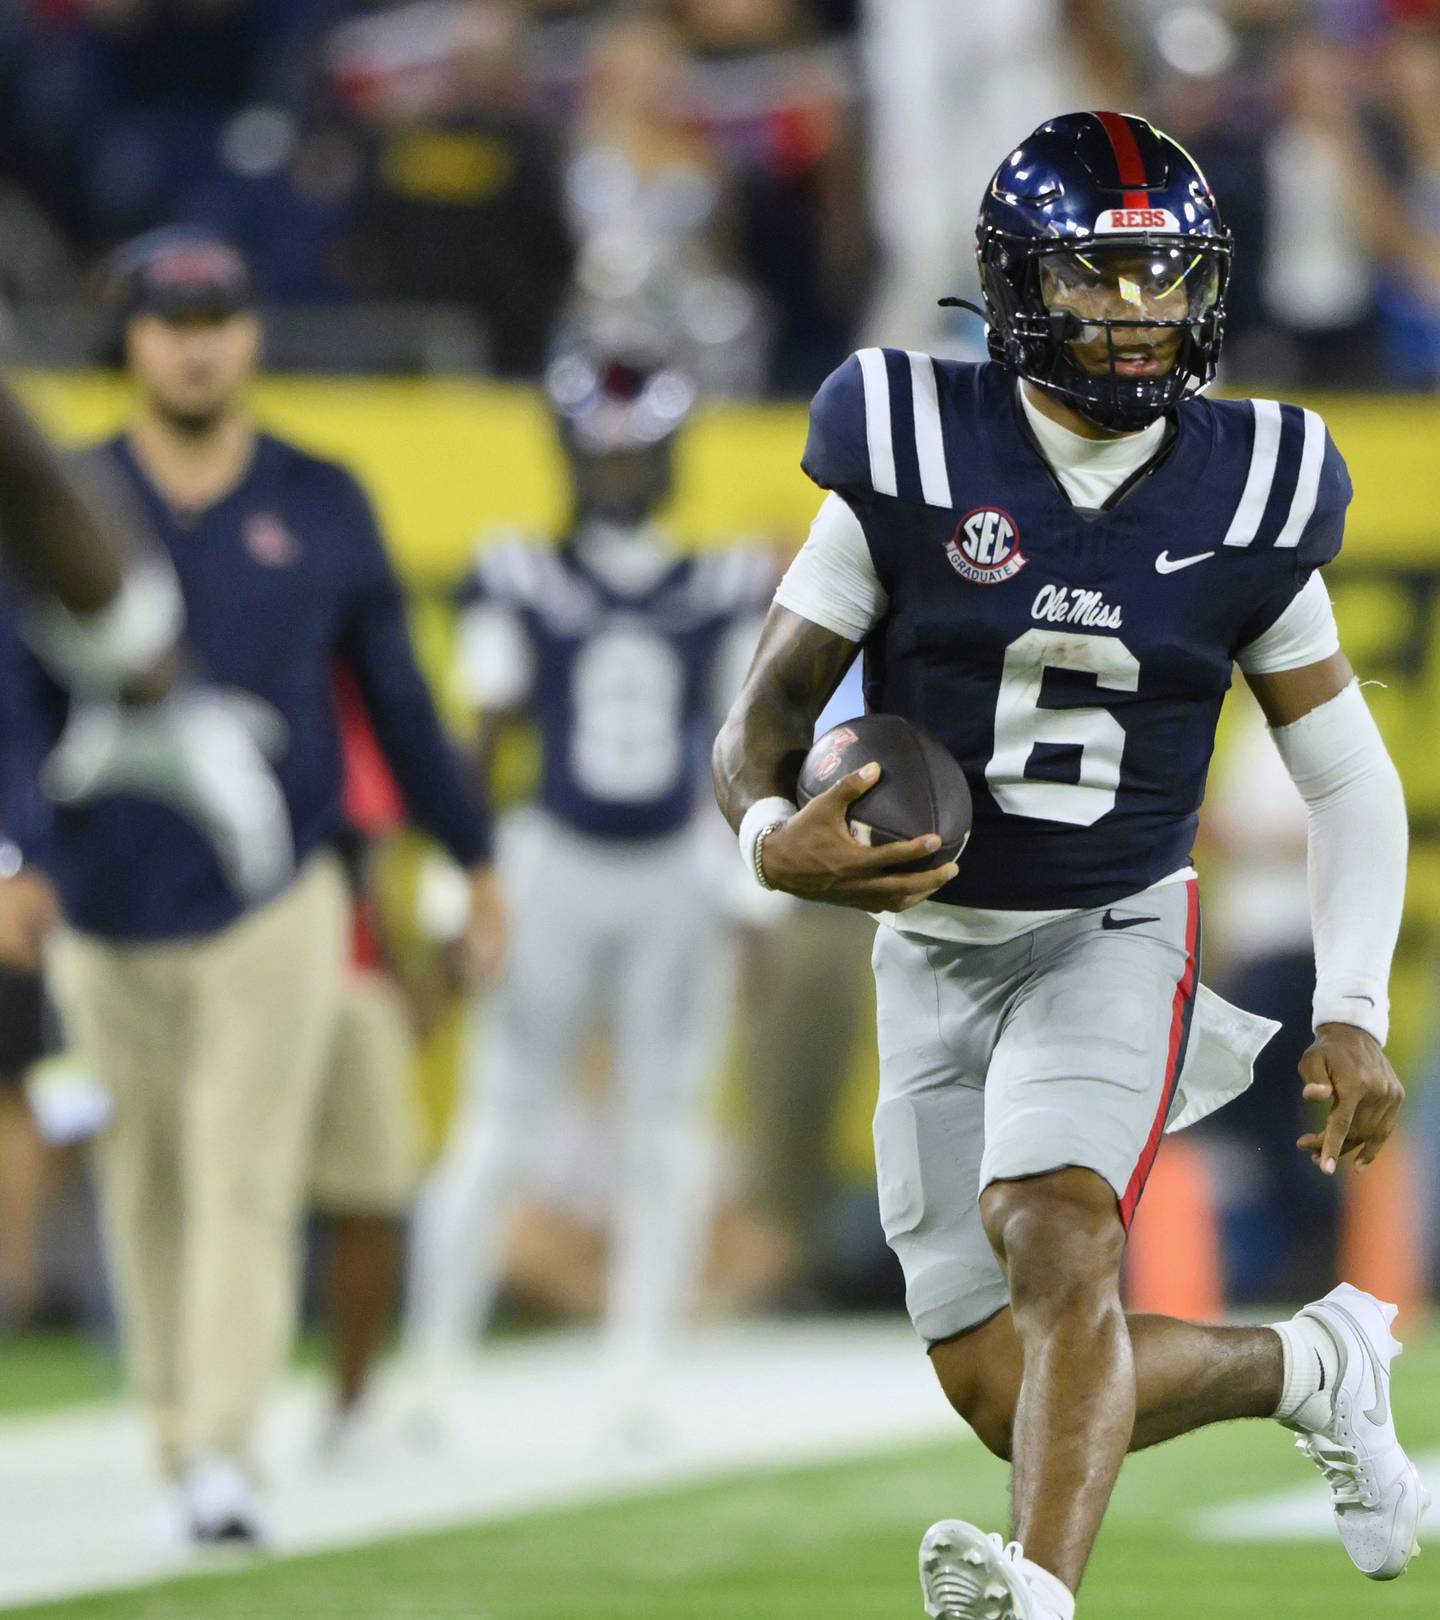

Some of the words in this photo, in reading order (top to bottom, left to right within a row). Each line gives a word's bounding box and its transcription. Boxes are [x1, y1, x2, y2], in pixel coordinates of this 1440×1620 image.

[1111, 210, 1166, 228] REBS
[962, 511, 1014, 565] SEC
[951, 553, 1013, 582] GRADUATE
[985, 628, 1141, 827] 6
